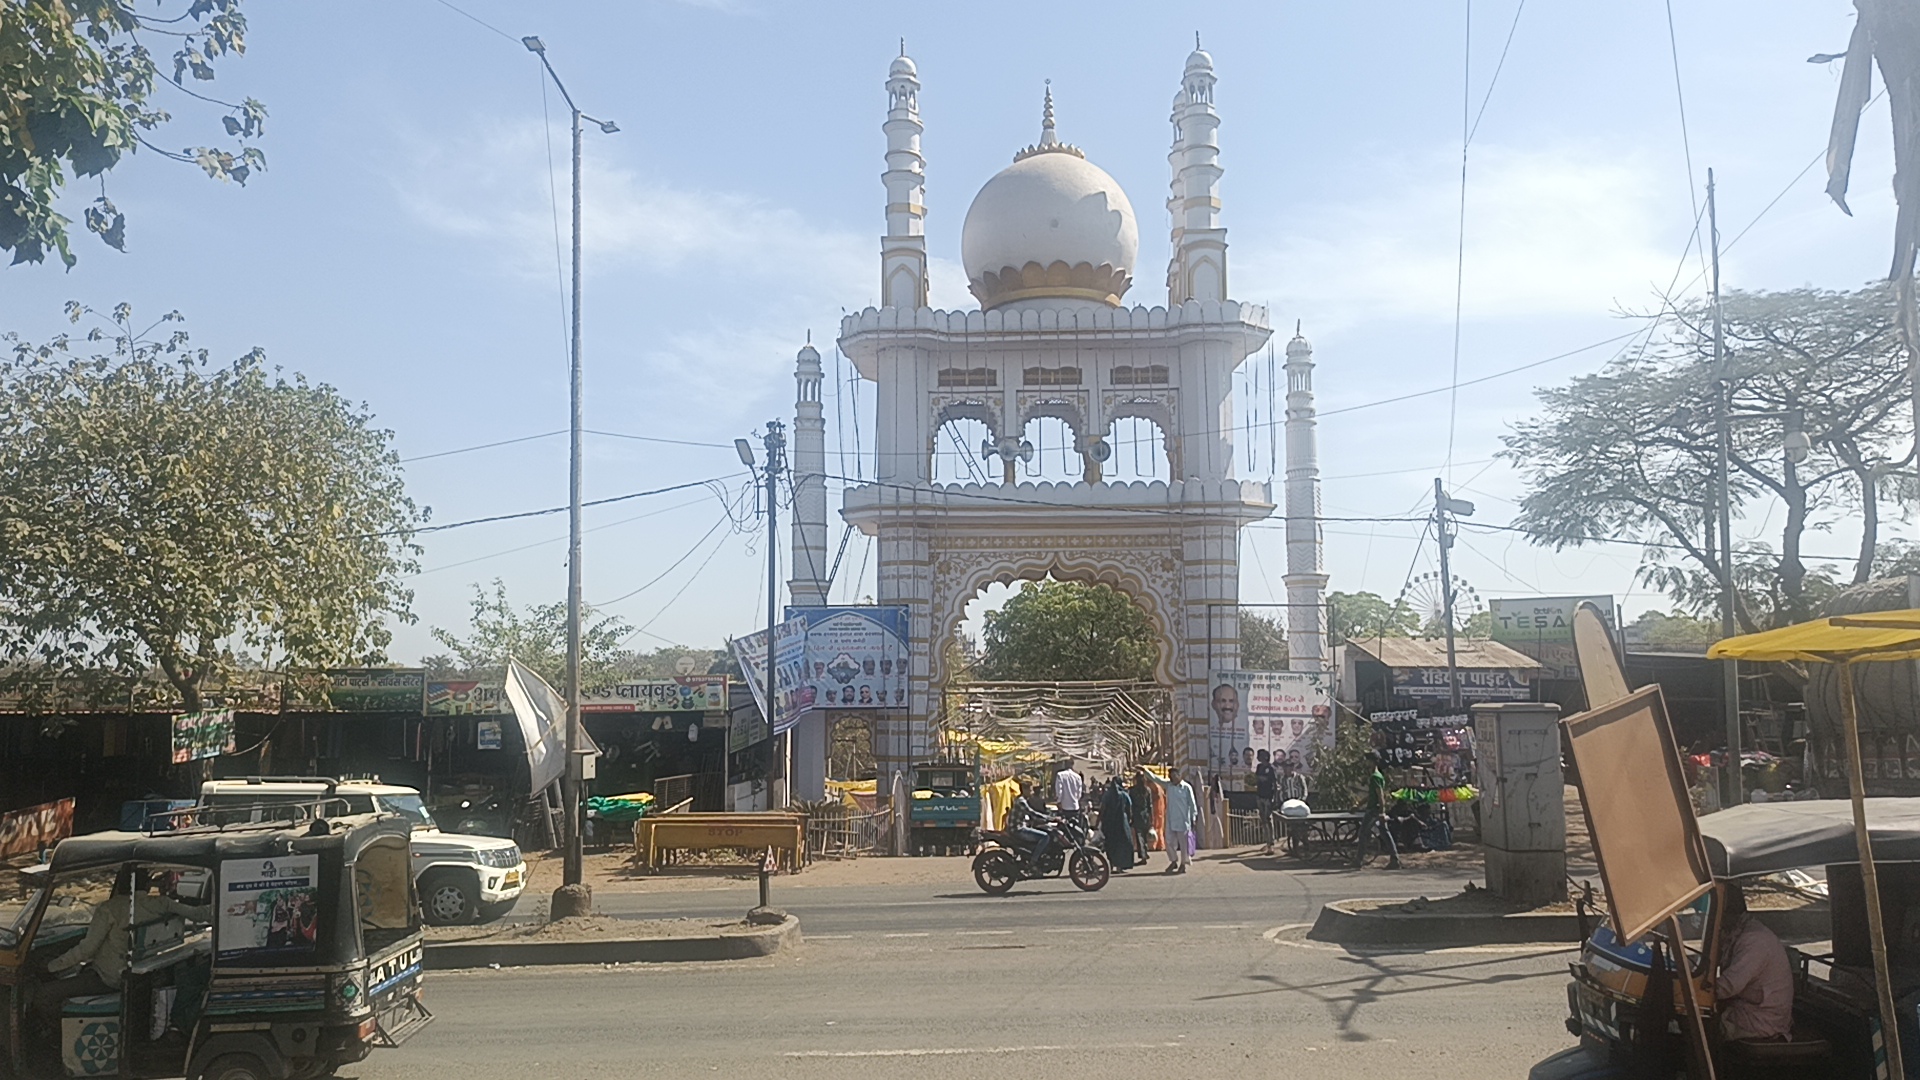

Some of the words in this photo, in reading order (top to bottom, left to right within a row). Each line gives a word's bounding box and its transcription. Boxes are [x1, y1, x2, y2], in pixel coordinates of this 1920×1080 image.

[1534, 607, 1562, 615] action
[1499, 615, 1567, 629] TESA
[615, 684, 677, 702] प्लायवुड
[708, 828, 742, 836] STOP
[376, 949, 419, 984] ATUL
